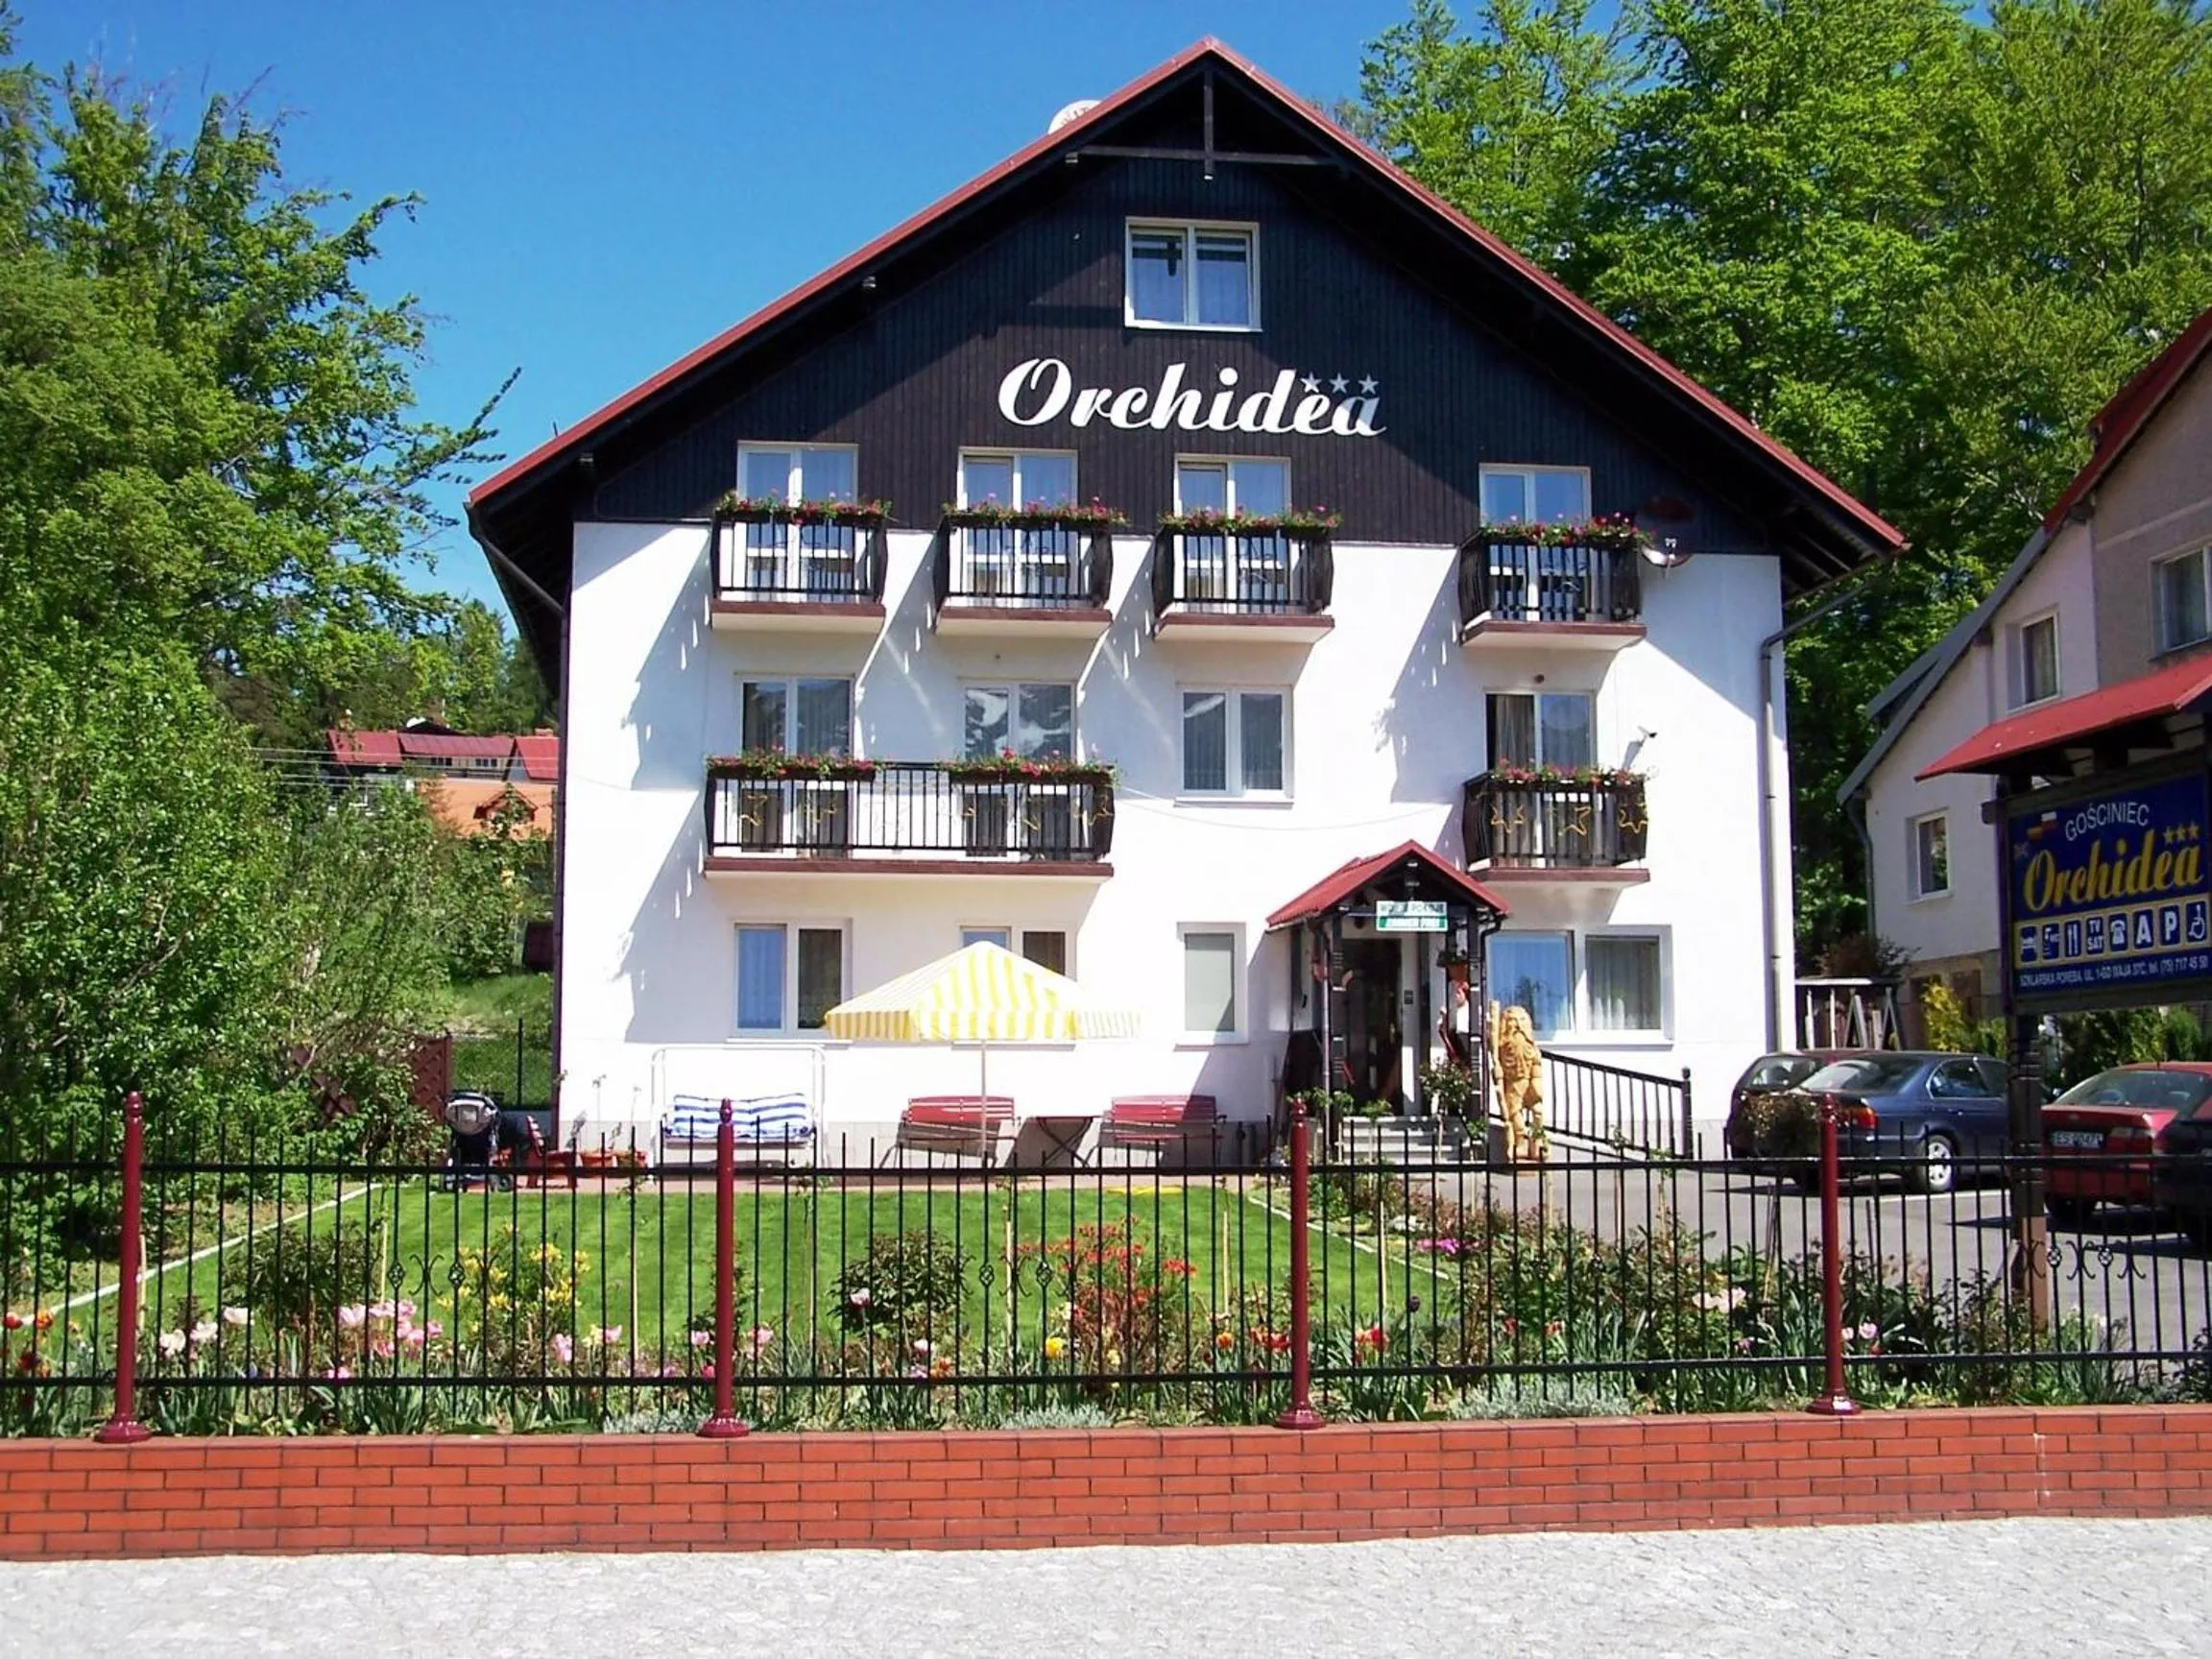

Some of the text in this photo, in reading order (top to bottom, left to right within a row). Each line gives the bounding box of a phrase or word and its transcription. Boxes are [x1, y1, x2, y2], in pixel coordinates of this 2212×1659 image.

[998, 357, 1387, 437] Orchidea
[2065, 801, 2151, 842] GOŚCINIEC
[2023, 829, 2204, 912] Orchidea
[2088, 919, 2102, 934] TV
[2135, 914, 2152, 945] A
[2164, 910, 2177, 942] P
[2087, 935, 2104, 950] SAT
